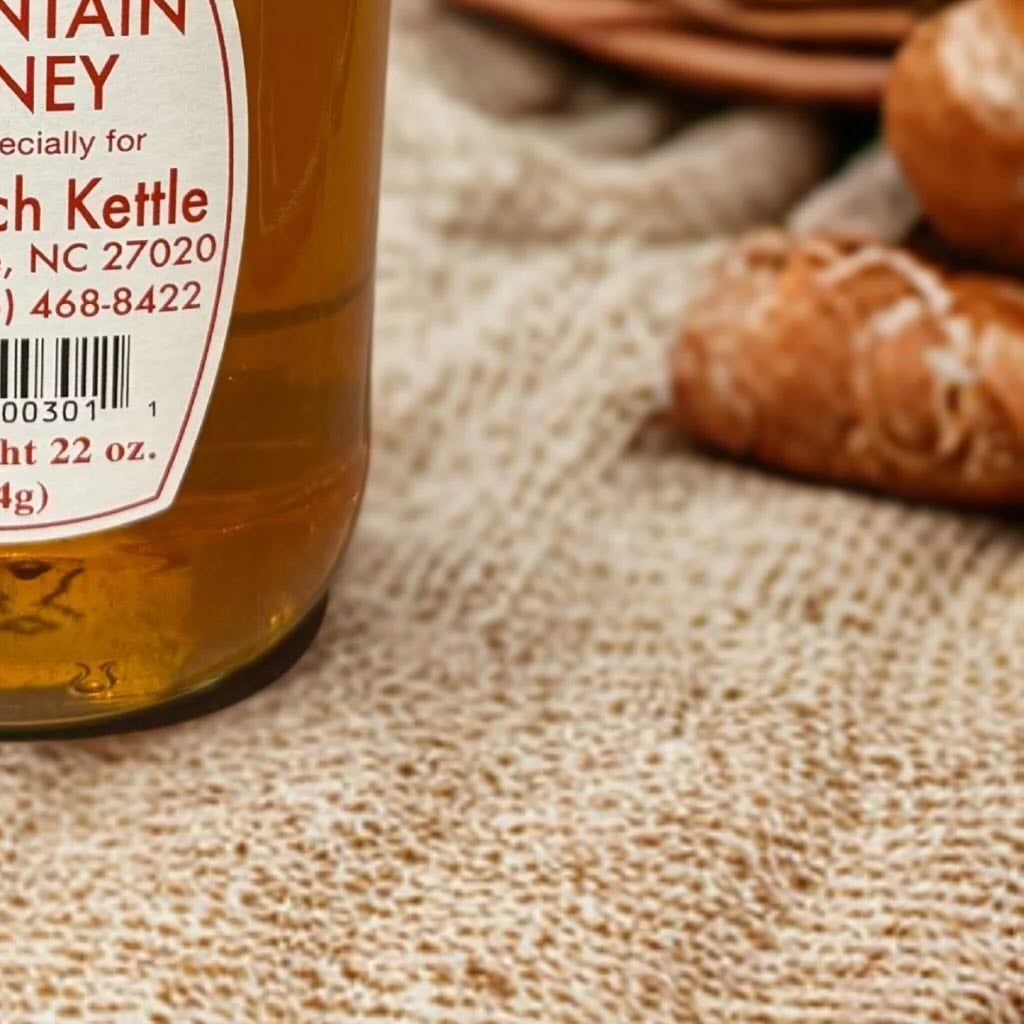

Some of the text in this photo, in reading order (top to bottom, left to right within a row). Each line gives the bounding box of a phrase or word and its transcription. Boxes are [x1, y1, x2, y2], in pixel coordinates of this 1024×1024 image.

[106, 129, 147, 153] for
[67, 168, 209, 230] Kettle
[30, 243, 88, 274] NC
[103, 233, 217, 270] 27020
[29, 281, 202, 319] 468-8422
[1, 399, 97, 423] 00301
[148, 400, 157, 417] 1
[50, 437, 92, 465] 22
[105, 441, 157, 462] oz.
